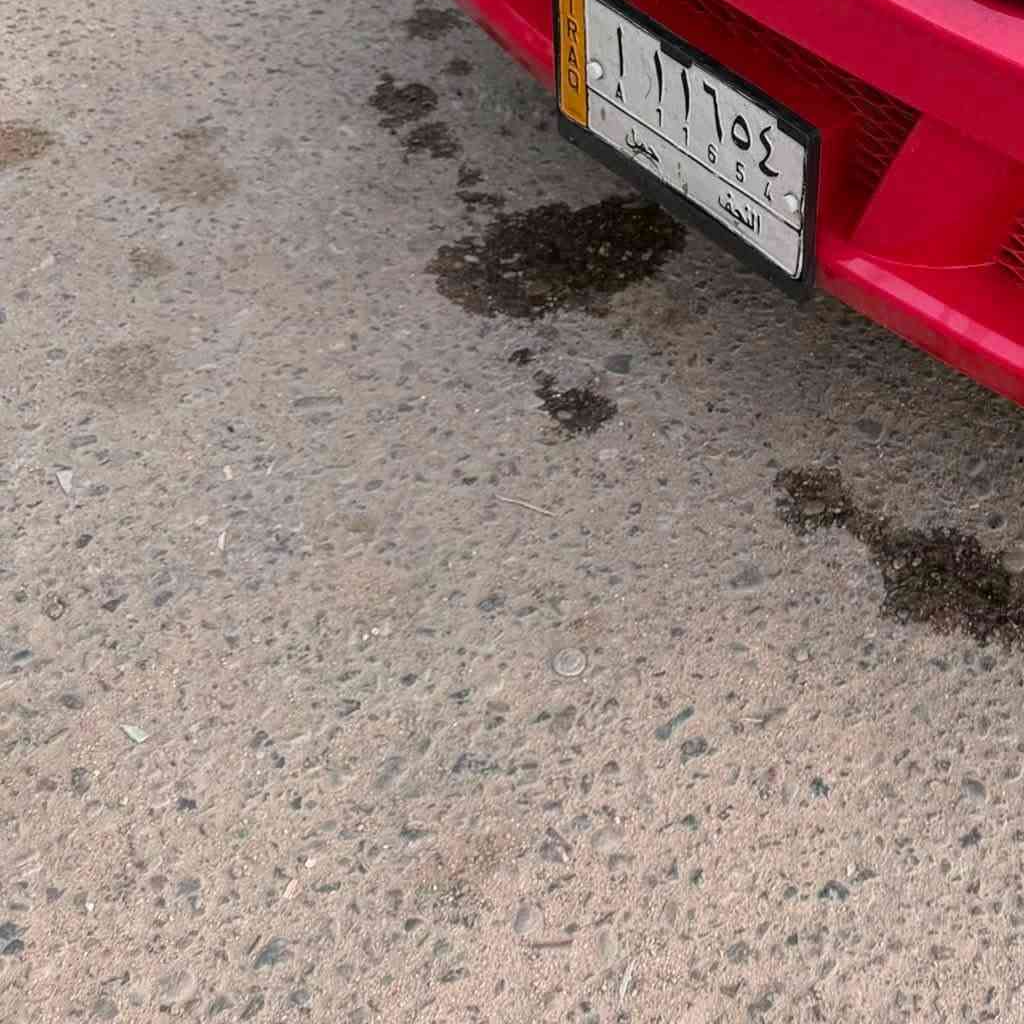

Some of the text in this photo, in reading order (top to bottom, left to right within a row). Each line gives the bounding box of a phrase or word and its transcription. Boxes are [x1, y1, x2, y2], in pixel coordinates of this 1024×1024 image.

[625, 127, 761, 234] النجف حمل
[655, 107, 772, 202] 11654
